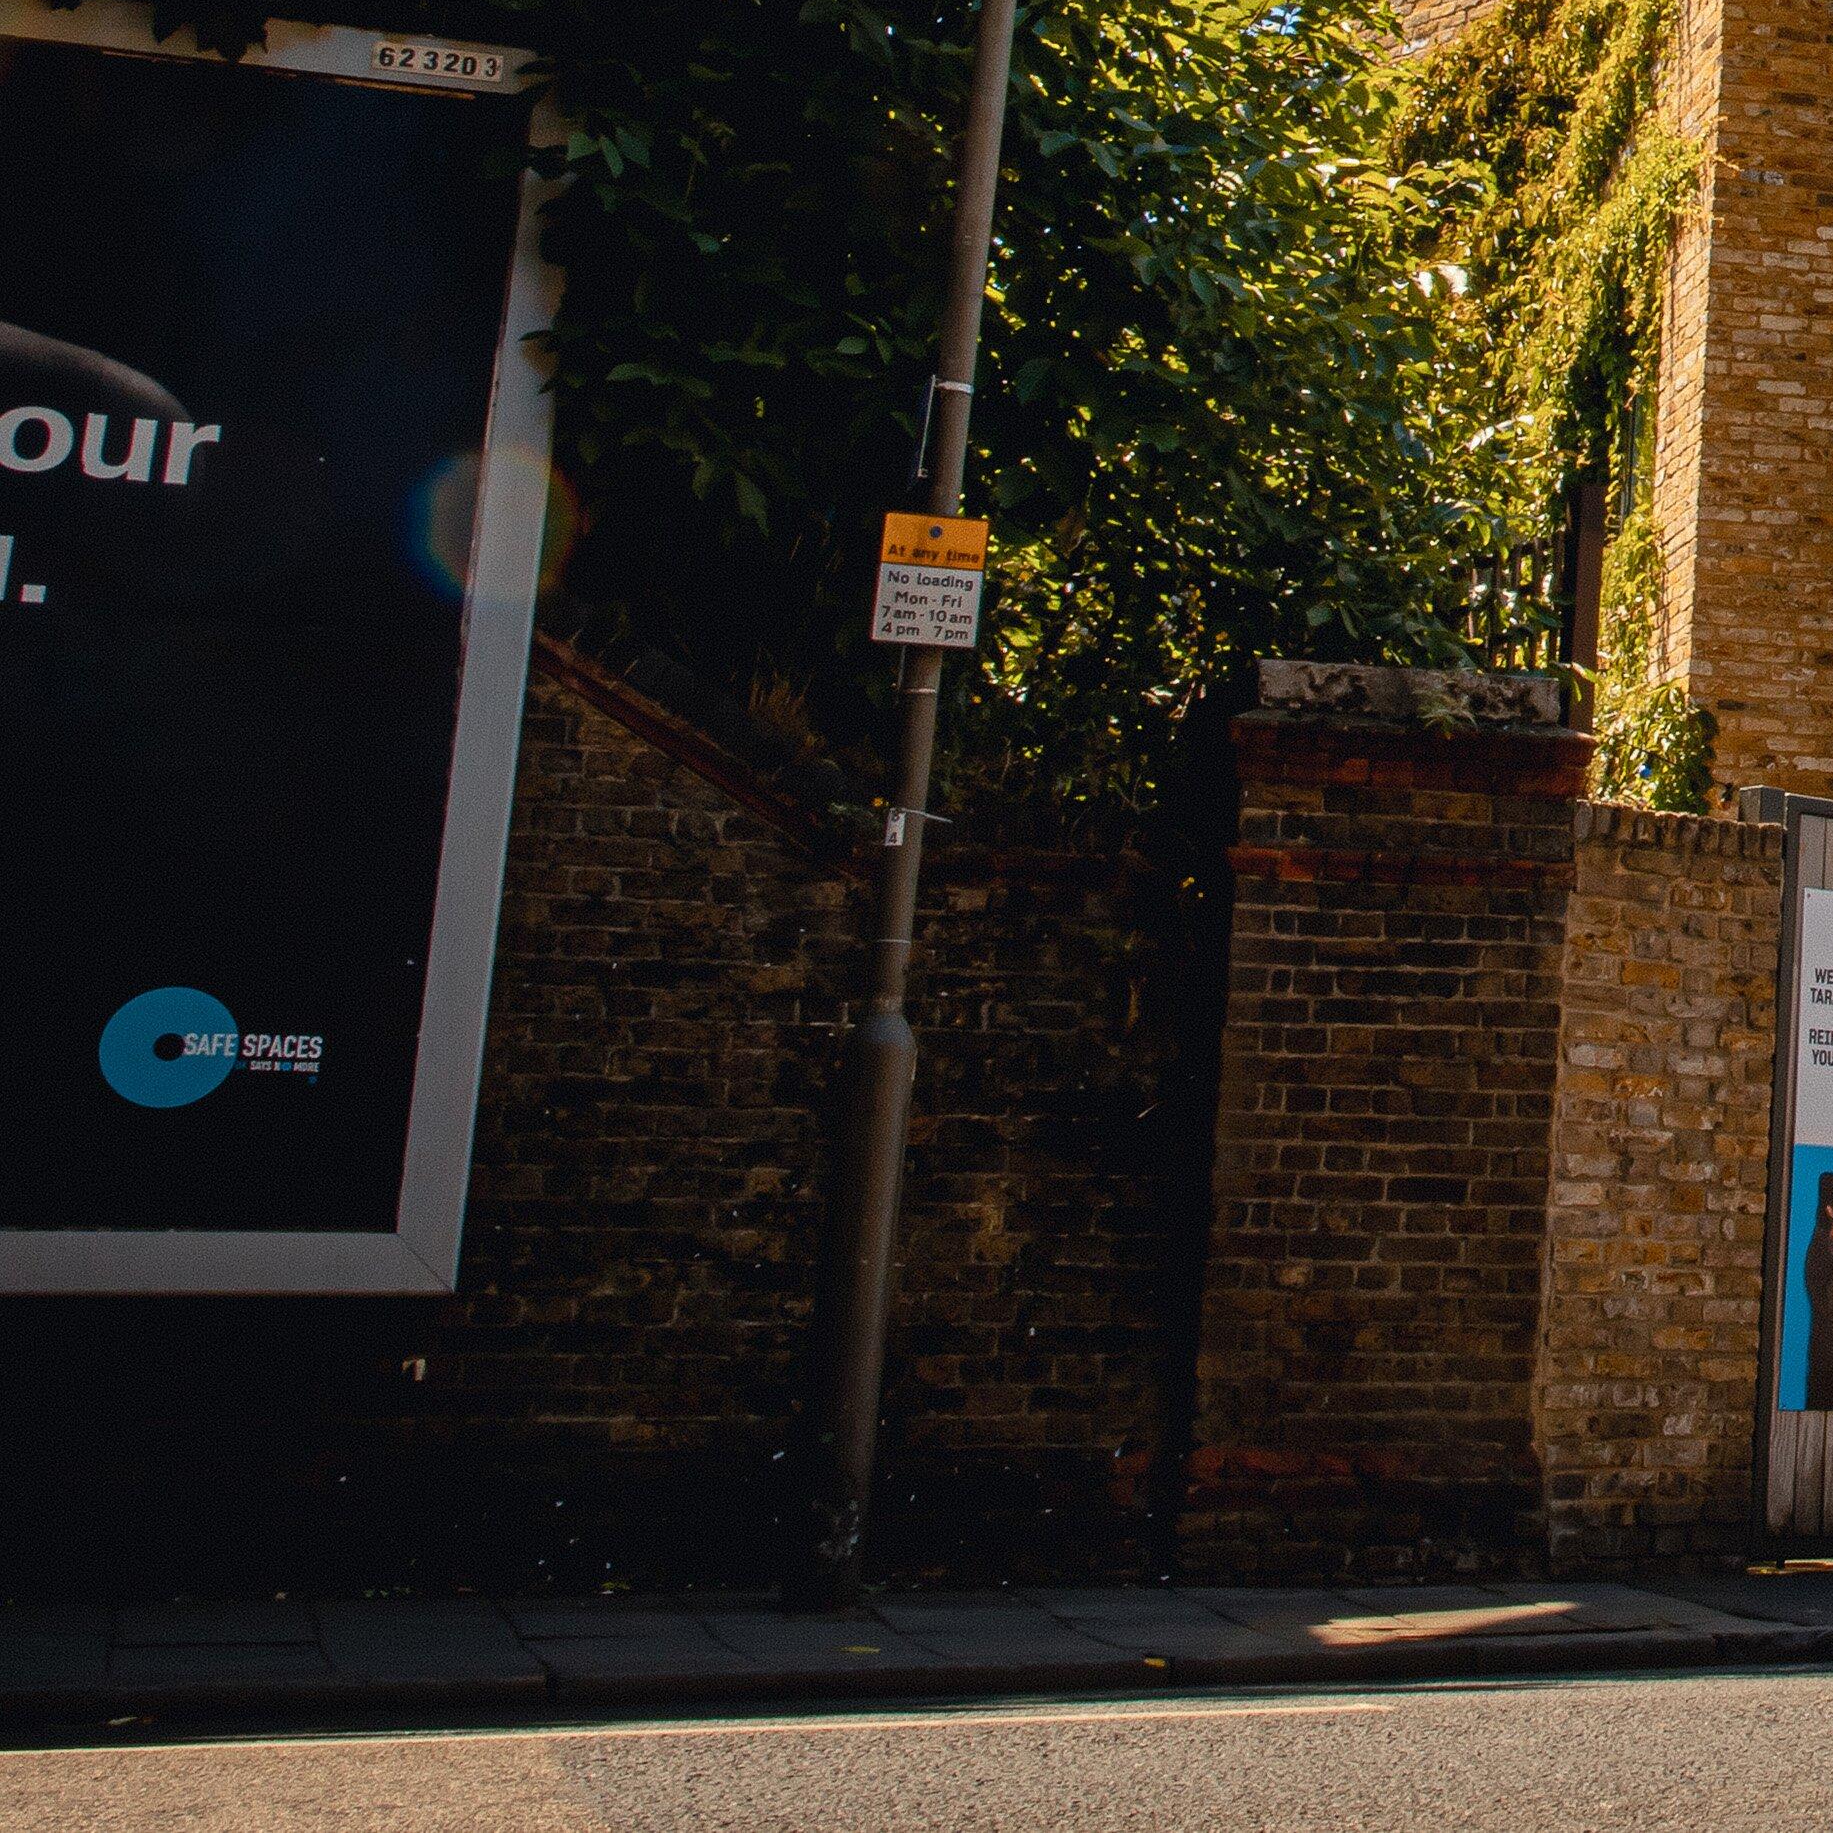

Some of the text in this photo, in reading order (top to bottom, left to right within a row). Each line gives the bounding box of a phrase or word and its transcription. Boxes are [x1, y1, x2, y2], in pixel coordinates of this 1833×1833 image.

[888, 544, 980, 563] At any time
[888, 570, 974, 592] No loading
[894, 591, 928, 605] Mon
[941, 594, 963, 608] Fri
[183, 1033, 323, 1059] SAFE SPACES
